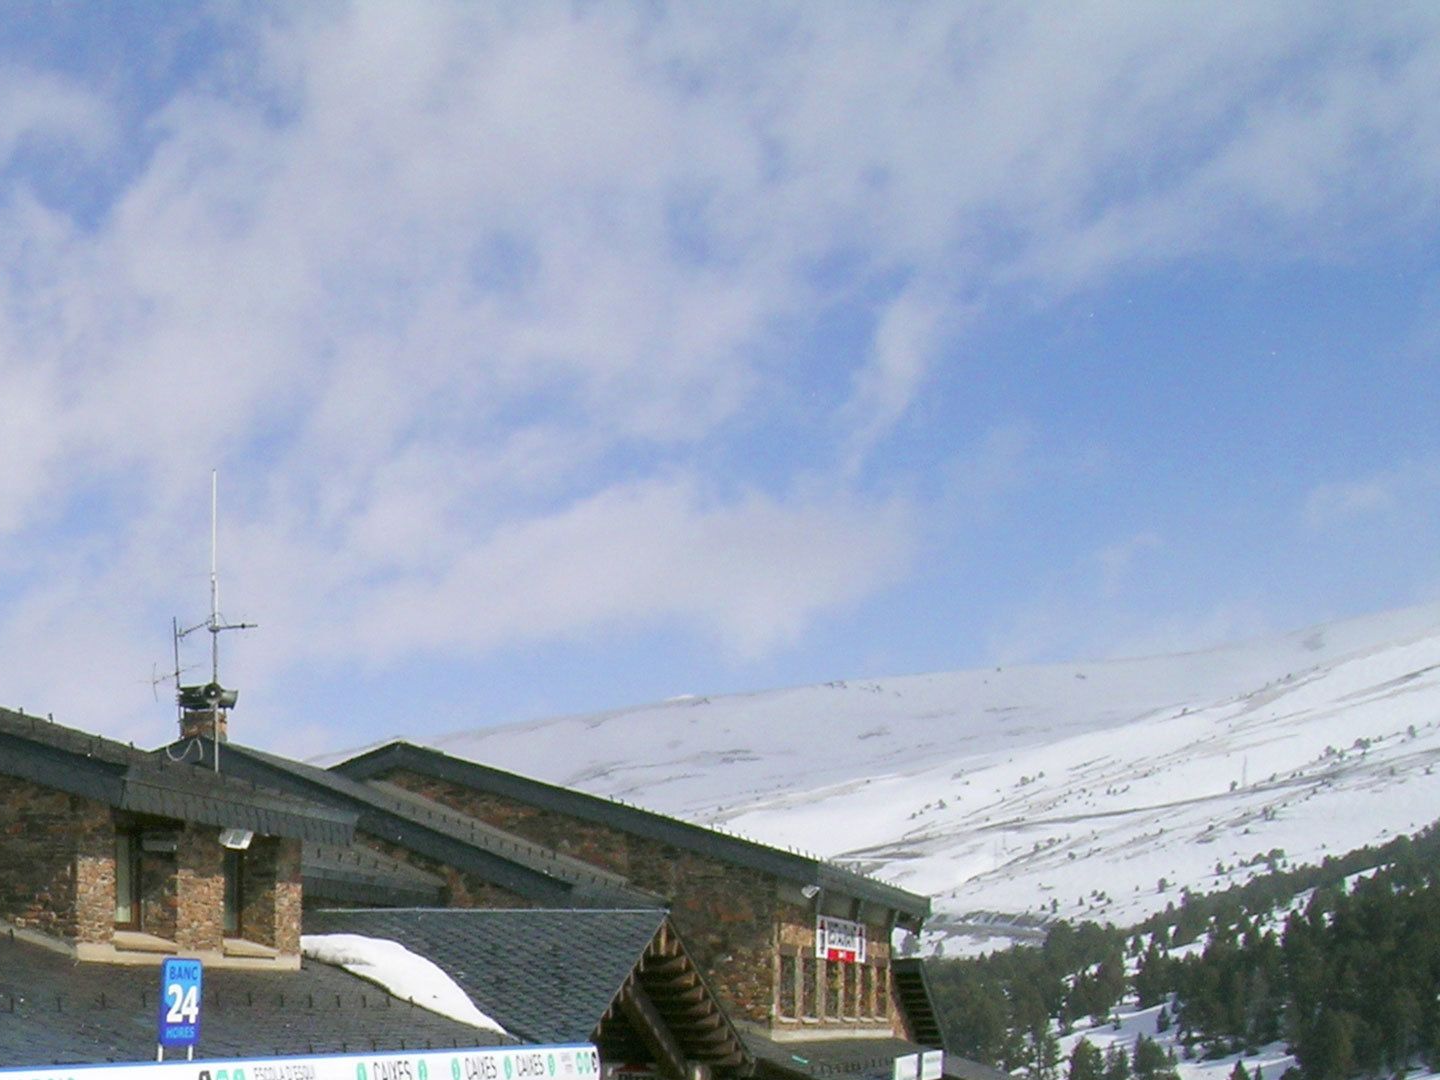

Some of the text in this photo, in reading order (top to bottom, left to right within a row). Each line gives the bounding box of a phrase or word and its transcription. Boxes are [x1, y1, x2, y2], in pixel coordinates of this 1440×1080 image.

[169, 966, 198, 980] BANC
[166, 984, 199, 1024] 24
[165, 1026, 195, 1039] HORES
[465, 1056, 497, 1080] CAIXES
[516, 1053, 545, 1077] CAIXES
